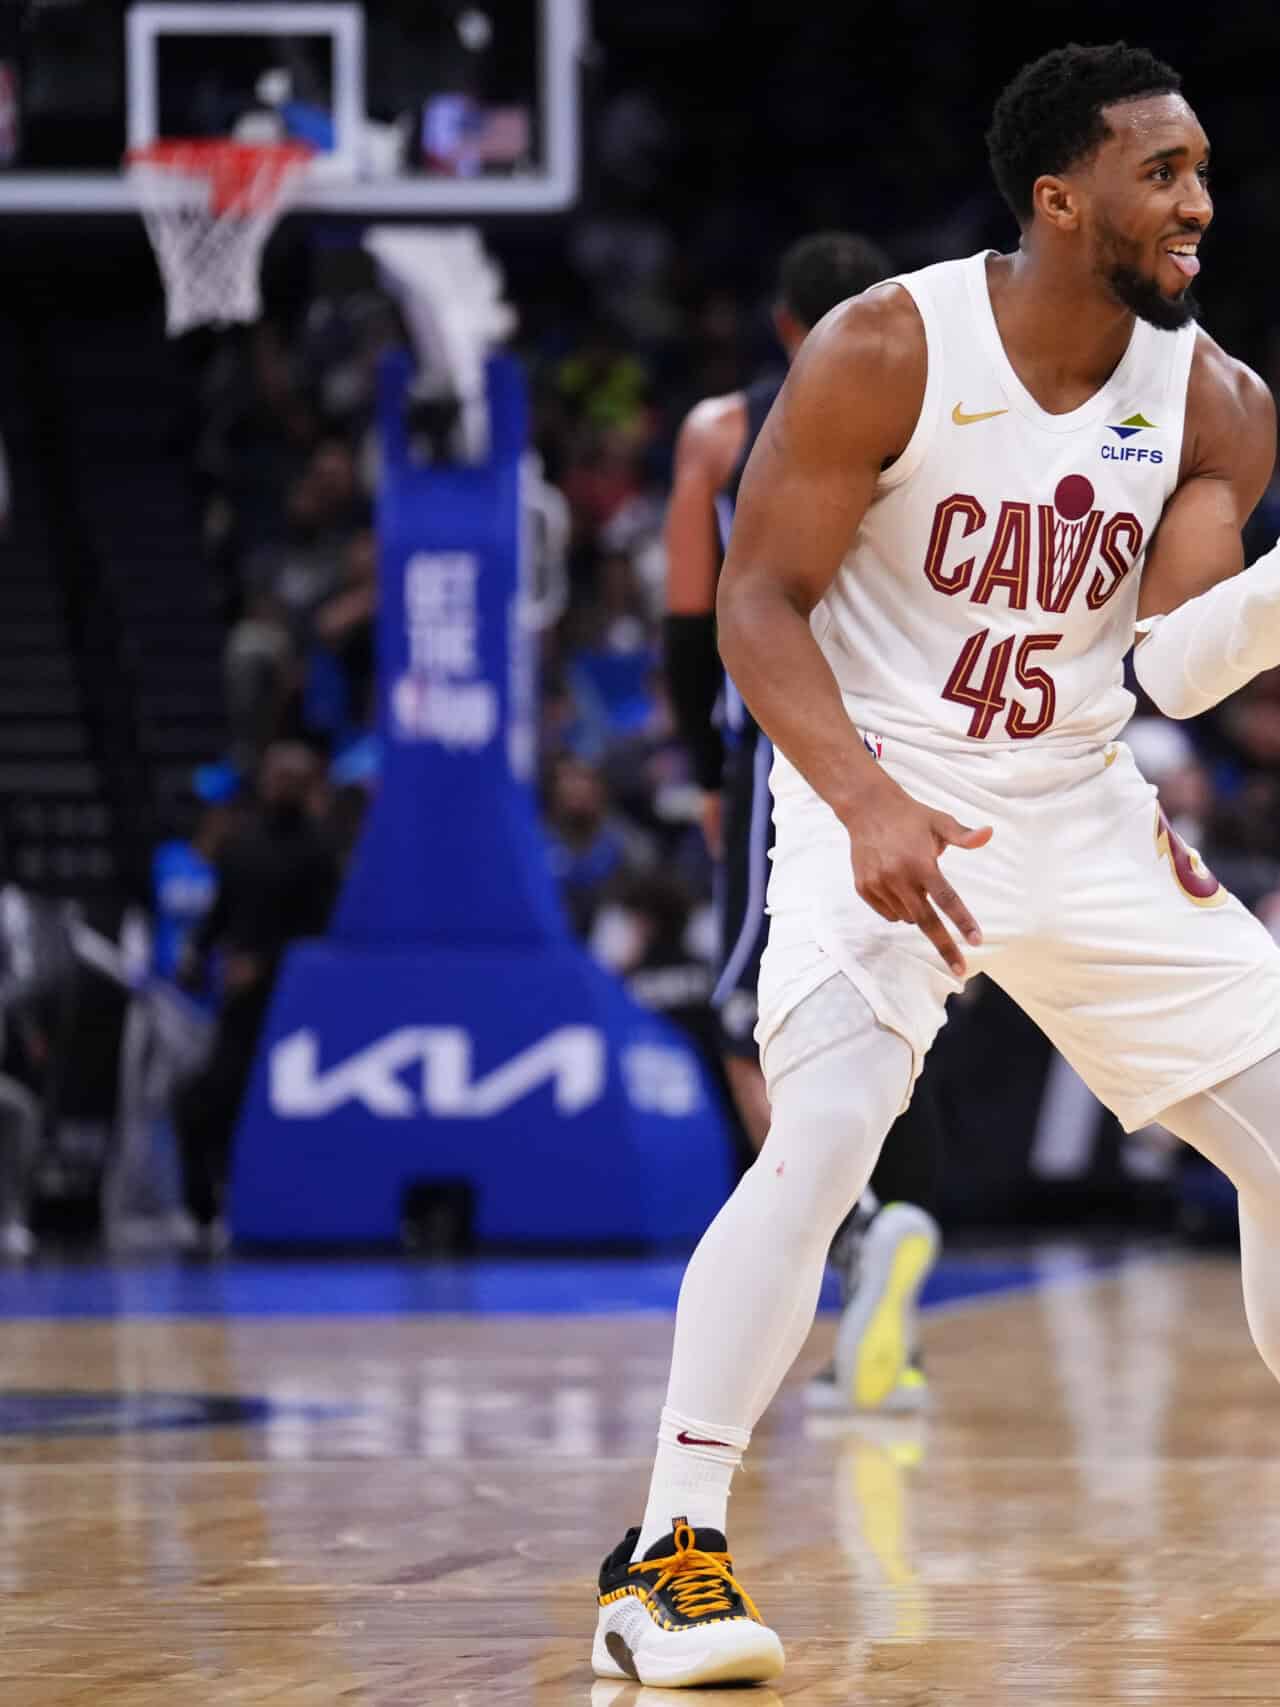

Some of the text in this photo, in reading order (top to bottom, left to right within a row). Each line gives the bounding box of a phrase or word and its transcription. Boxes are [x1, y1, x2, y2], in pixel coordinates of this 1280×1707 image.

[1101, 445, 1164, 464] CLIFFS
[924, 493, 1144, 613] CAVS
[940, 627, 1064, 740] 45
